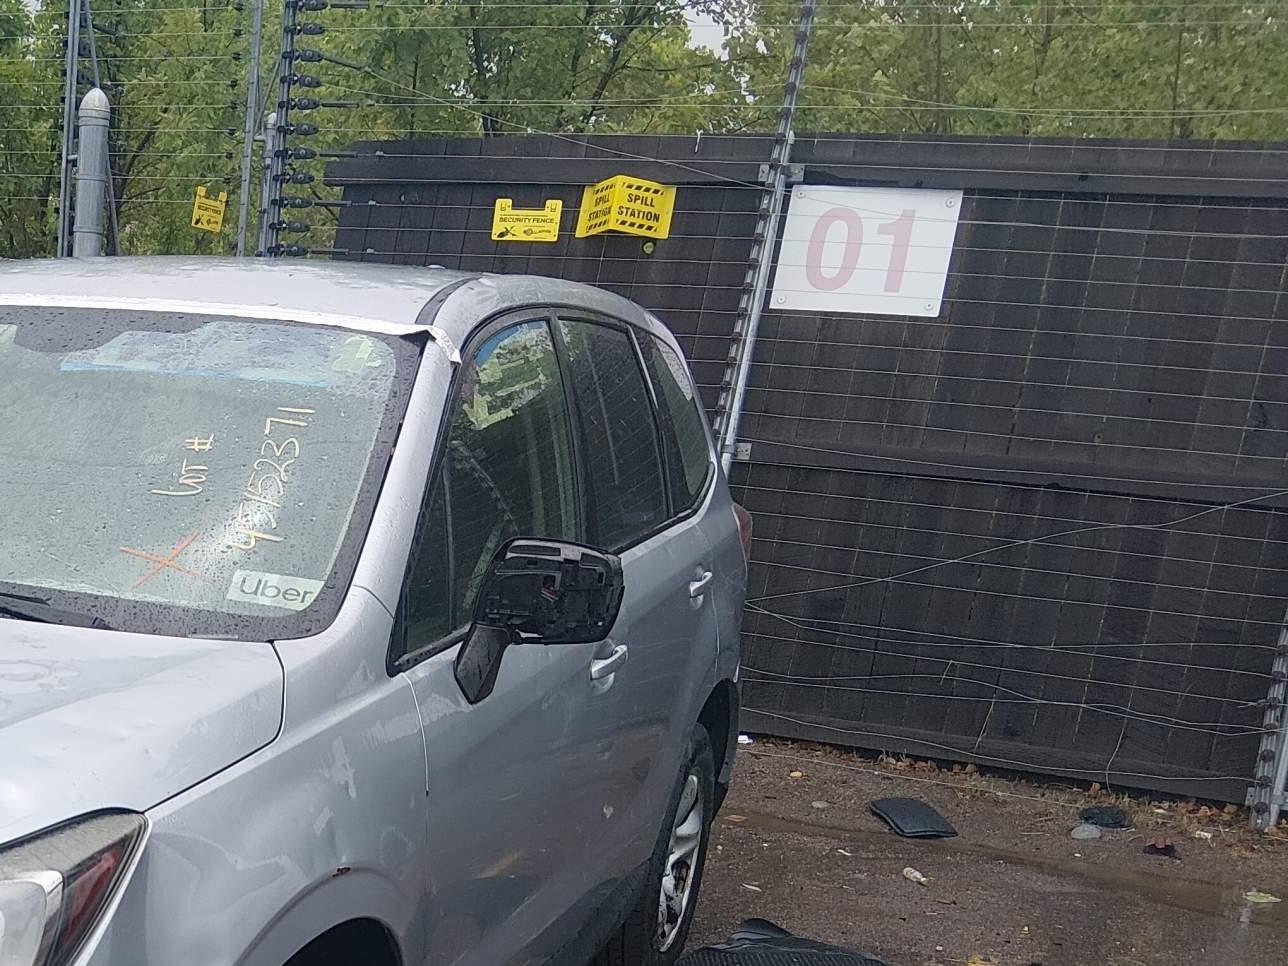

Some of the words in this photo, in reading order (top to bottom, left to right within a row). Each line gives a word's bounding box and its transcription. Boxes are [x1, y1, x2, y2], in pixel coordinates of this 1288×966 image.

[594, 193, 610, 207] SPILL
[627, 192, 655, 208] SPILL
[617, 205, 661, 223] STATION
[805, 207, 917, 293] 01
[239, 575, 314, 604] Uber
